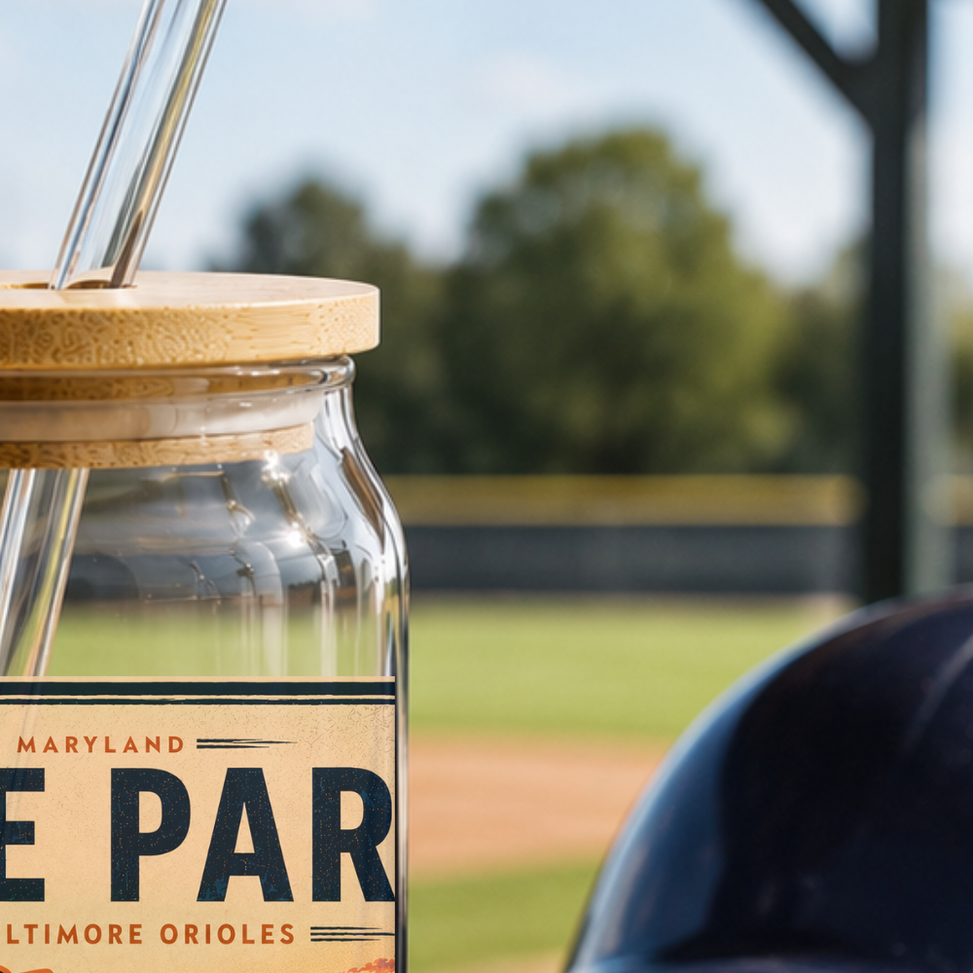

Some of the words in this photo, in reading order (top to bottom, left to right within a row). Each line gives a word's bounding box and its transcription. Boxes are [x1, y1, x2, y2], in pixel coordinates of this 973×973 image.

[16, 735, 185, 754] MARYLAND
[109, 766, 395, 903] PAR
[159, 923, 295, 945] ORIOLES
